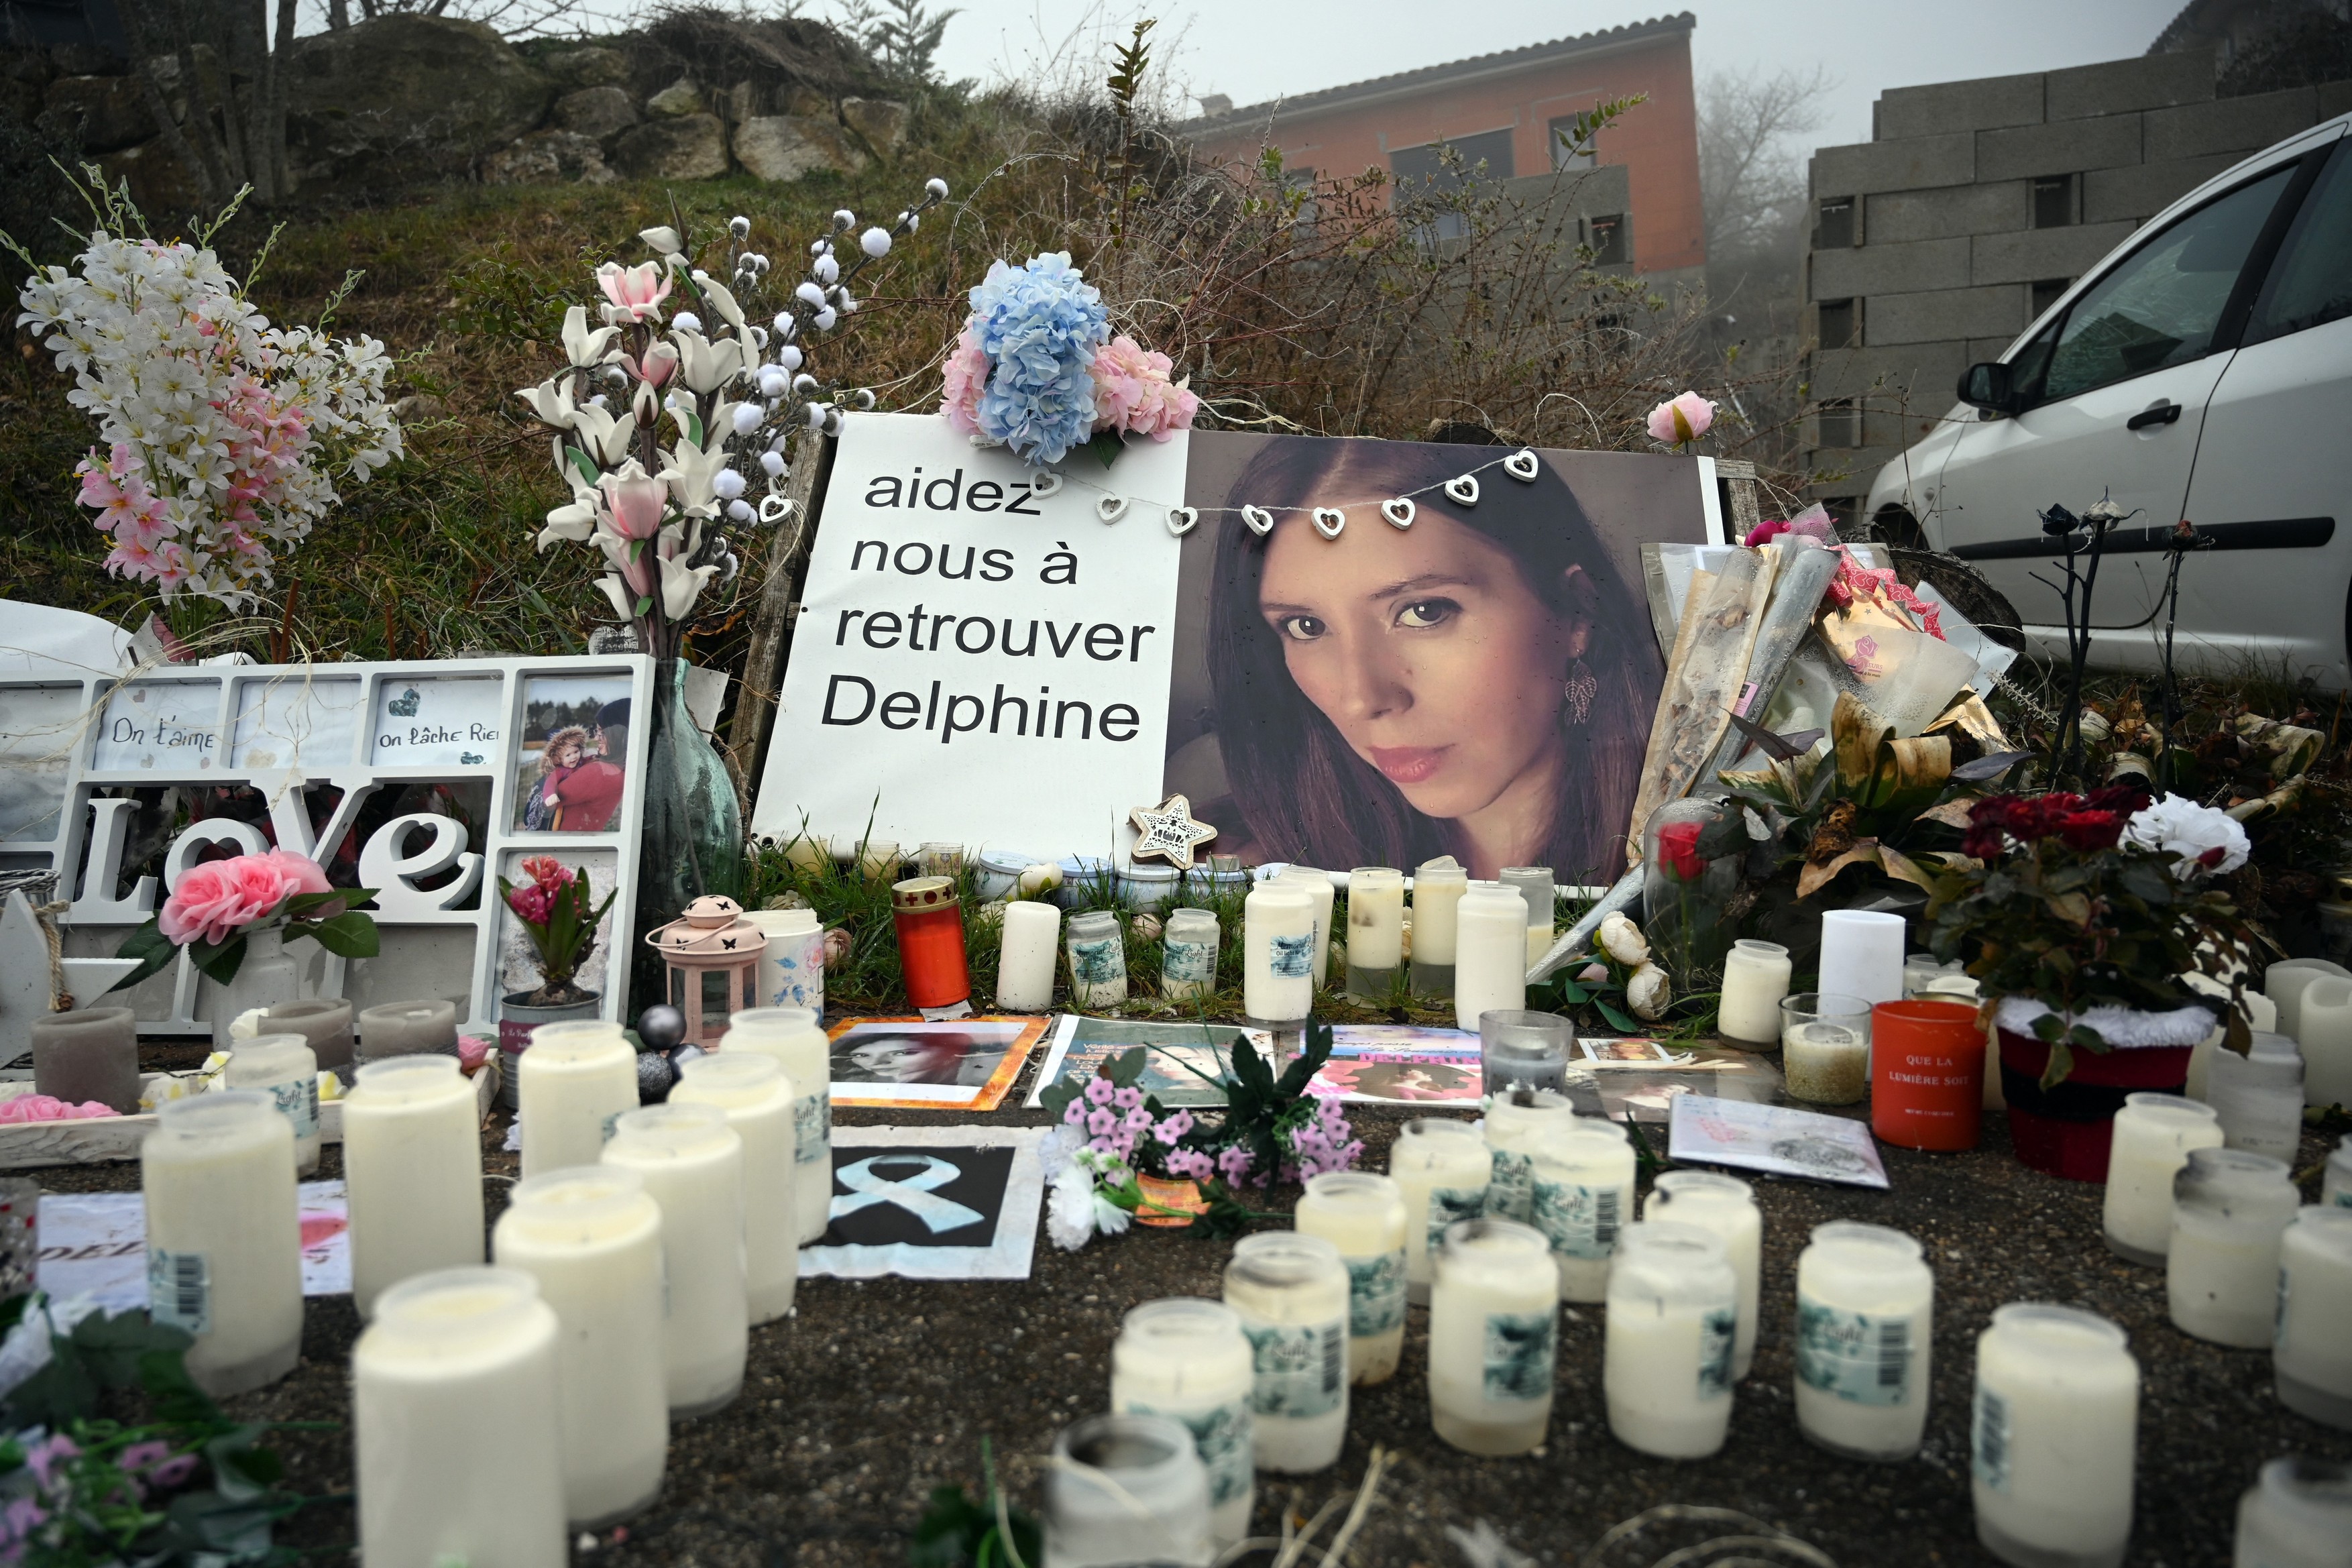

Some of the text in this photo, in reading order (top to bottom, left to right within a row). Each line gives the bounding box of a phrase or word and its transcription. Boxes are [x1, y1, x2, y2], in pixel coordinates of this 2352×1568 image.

[864, 466, 1043, 516] aidez
[850, 540, 1078, 584] nous à
[836, 604, 1155, 662] retrouver
[821, 674, 1140, 744] Delphine
[113, 718, 144, 744] On
[408, 726, 463, 745] lâche
[1107, 942, 1121, 954] Light
[1185, 948, 1203, 959] Light
[1357, 1052, 1480, 1066] DELPHIN
[1906, 1054, 1953, 1066] QUE LA
[1889, 1070, 1969, 1086] LUMIÈRE SOIT
